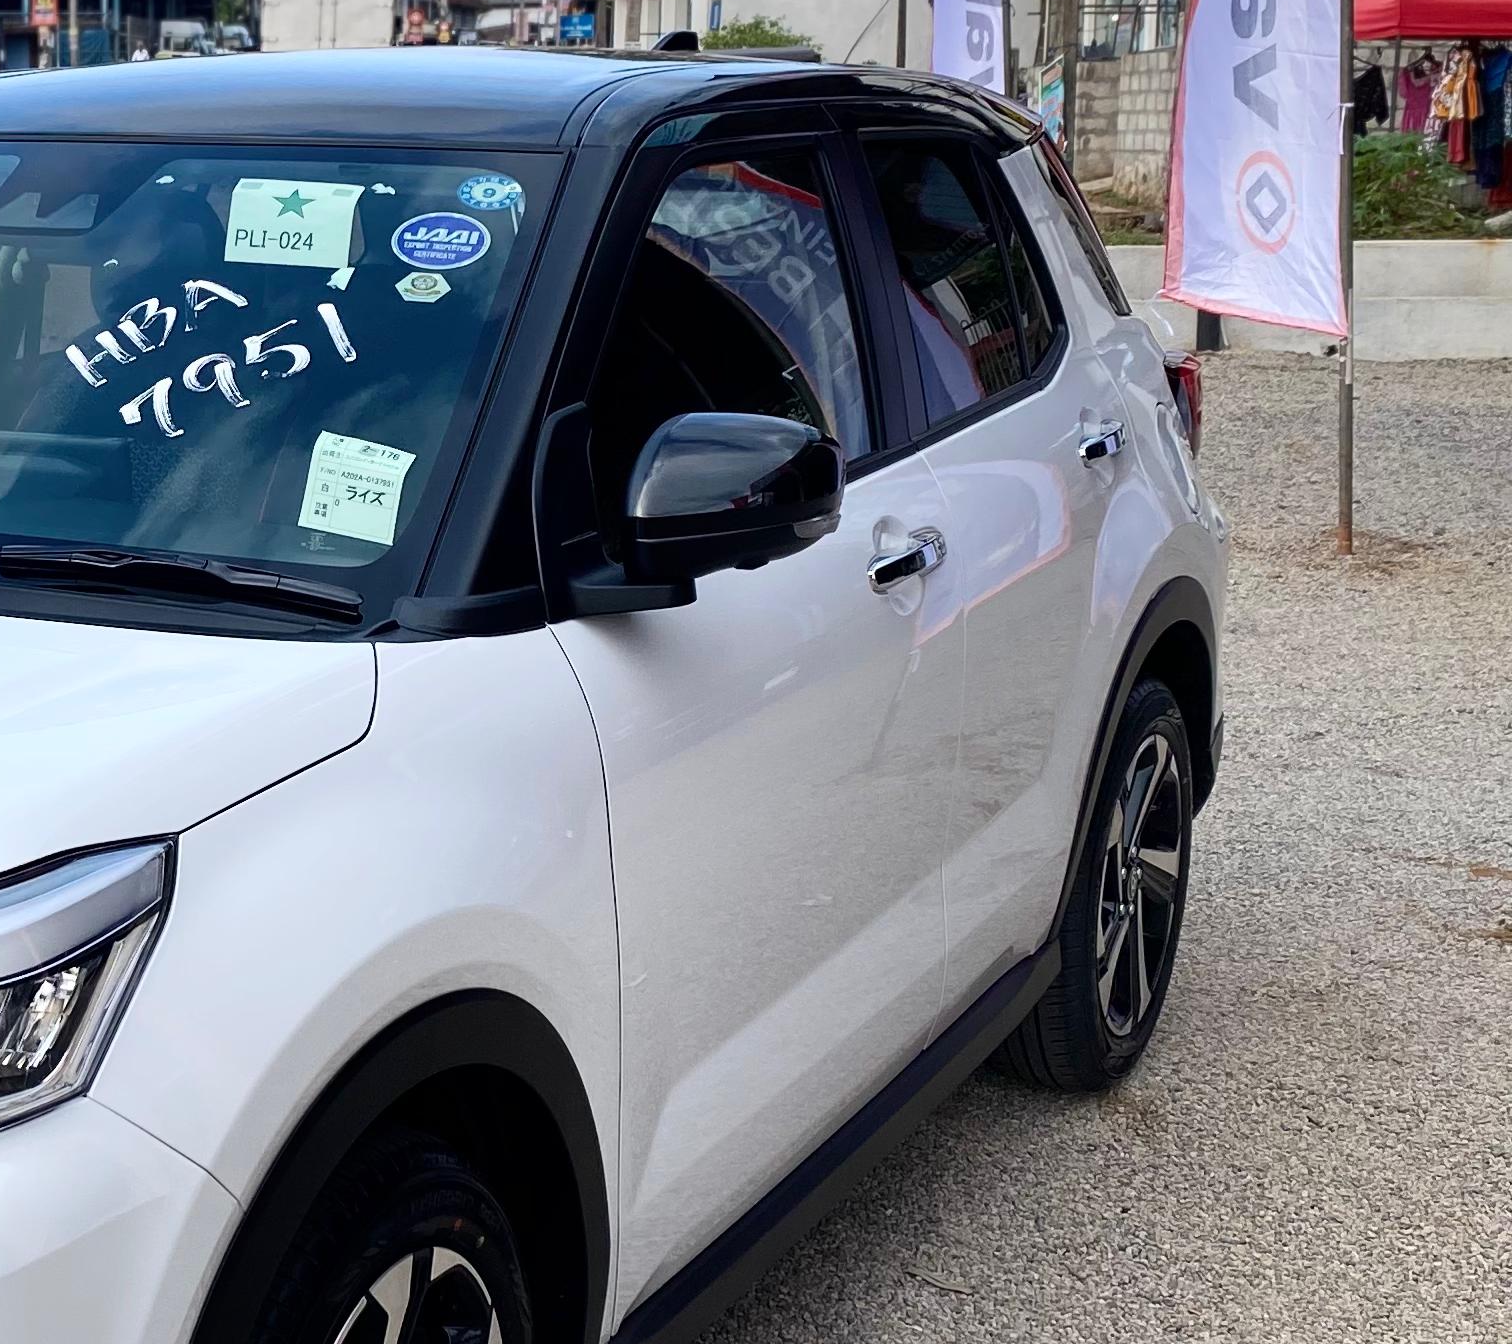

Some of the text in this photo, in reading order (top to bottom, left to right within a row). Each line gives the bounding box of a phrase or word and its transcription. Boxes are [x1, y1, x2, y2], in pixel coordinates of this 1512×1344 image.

[234, 228, 314, 251] PLI-024
[403, 227, 480, 245] JAAI
[65, 279, 249, 388] HBA
[118, 303, 357, 438] 7951
[345, 485, 386, 506] ライズ
